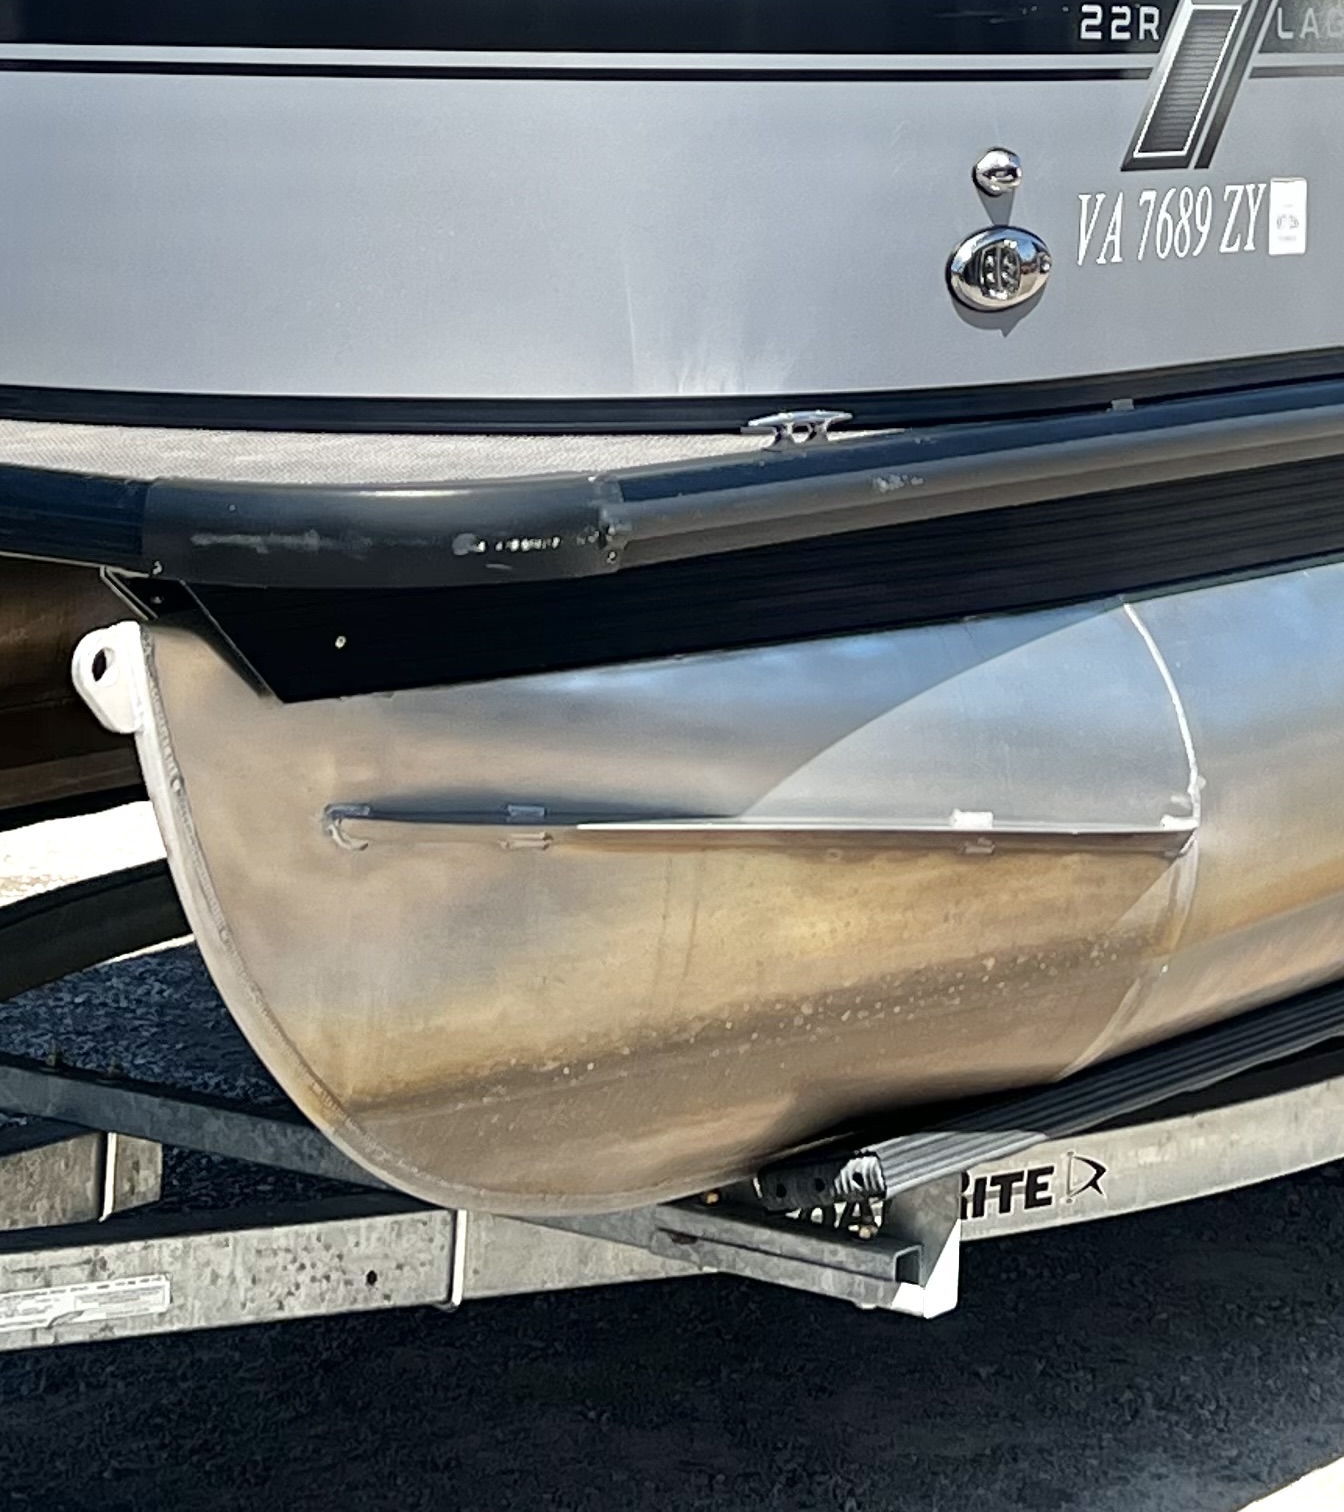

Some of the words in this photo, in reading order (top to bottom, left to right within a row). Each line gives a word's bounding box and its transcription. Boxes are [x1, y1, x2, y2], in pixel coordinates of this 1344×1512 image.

[1080, 4, 1160, 40] 22R
[1077, 192, 1124, 266] VA
[1138, 186, 1213, 260] 7689
[1218, 183, 1267, 253] ZY
